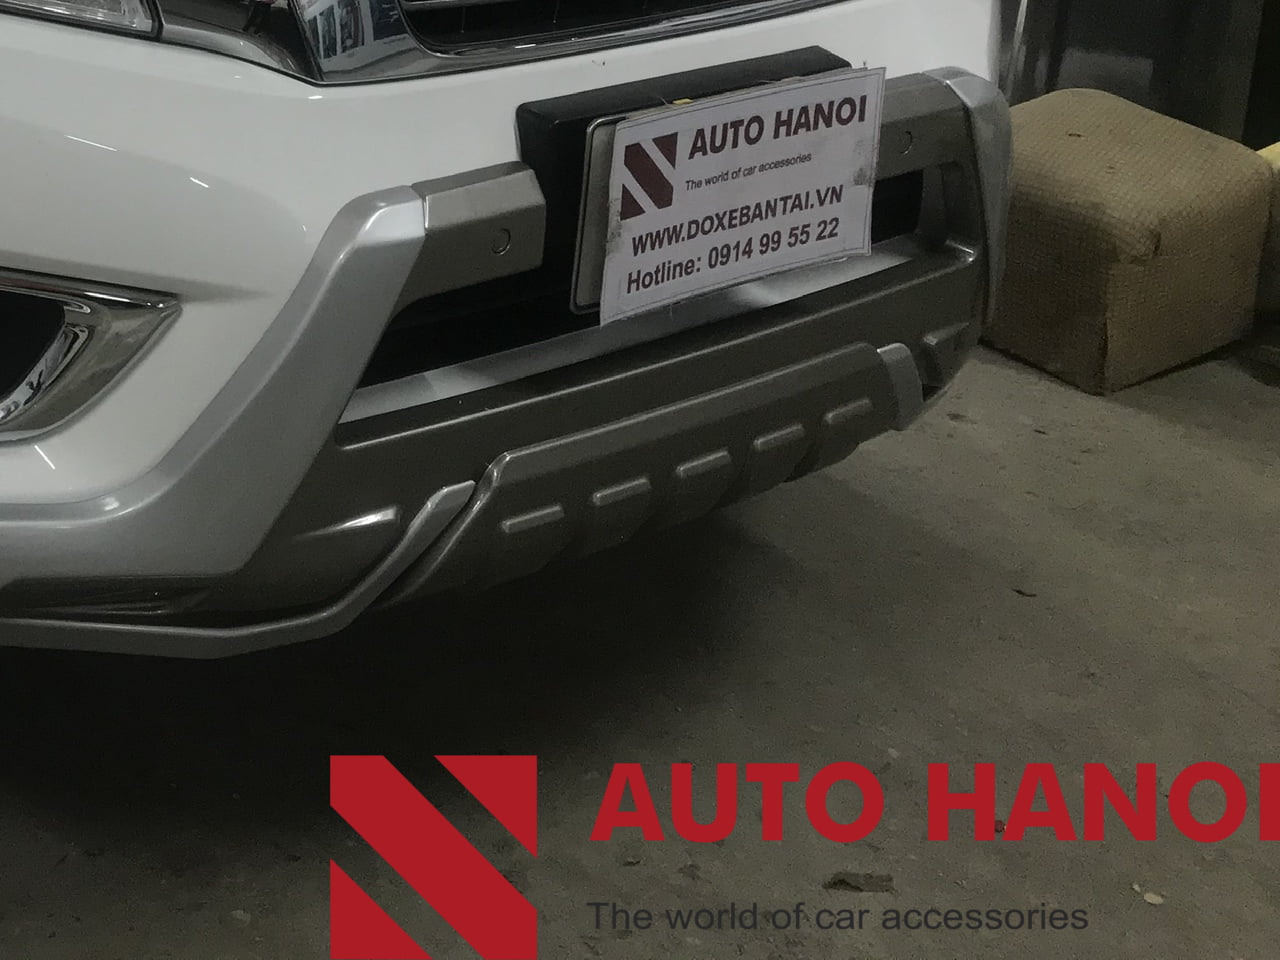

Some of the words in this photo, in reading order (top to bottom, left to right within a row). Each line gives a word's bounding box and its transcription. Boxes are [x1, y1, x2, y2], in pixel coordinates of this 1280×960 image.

[688, 115, 765, 160] AUTO
[773, 94, 868, 140] HANOI
[685, 178, 703, 191] The
[704, 169, 730, 187] world
[731, 166, 742, 180] of
[742, 164, 757, 177] car
[758, 152, 812, 173] accessories
[631, 184, 844, 257] WWW.DOXEBANTAI.VN
[626, 256, 702, 294] Hotline:
[708, 237, 754, 269] 0914
[759, 230, 782, 253] 99
[787, 223, 811, 248] 55
[815, 217, 840, 242] 22
